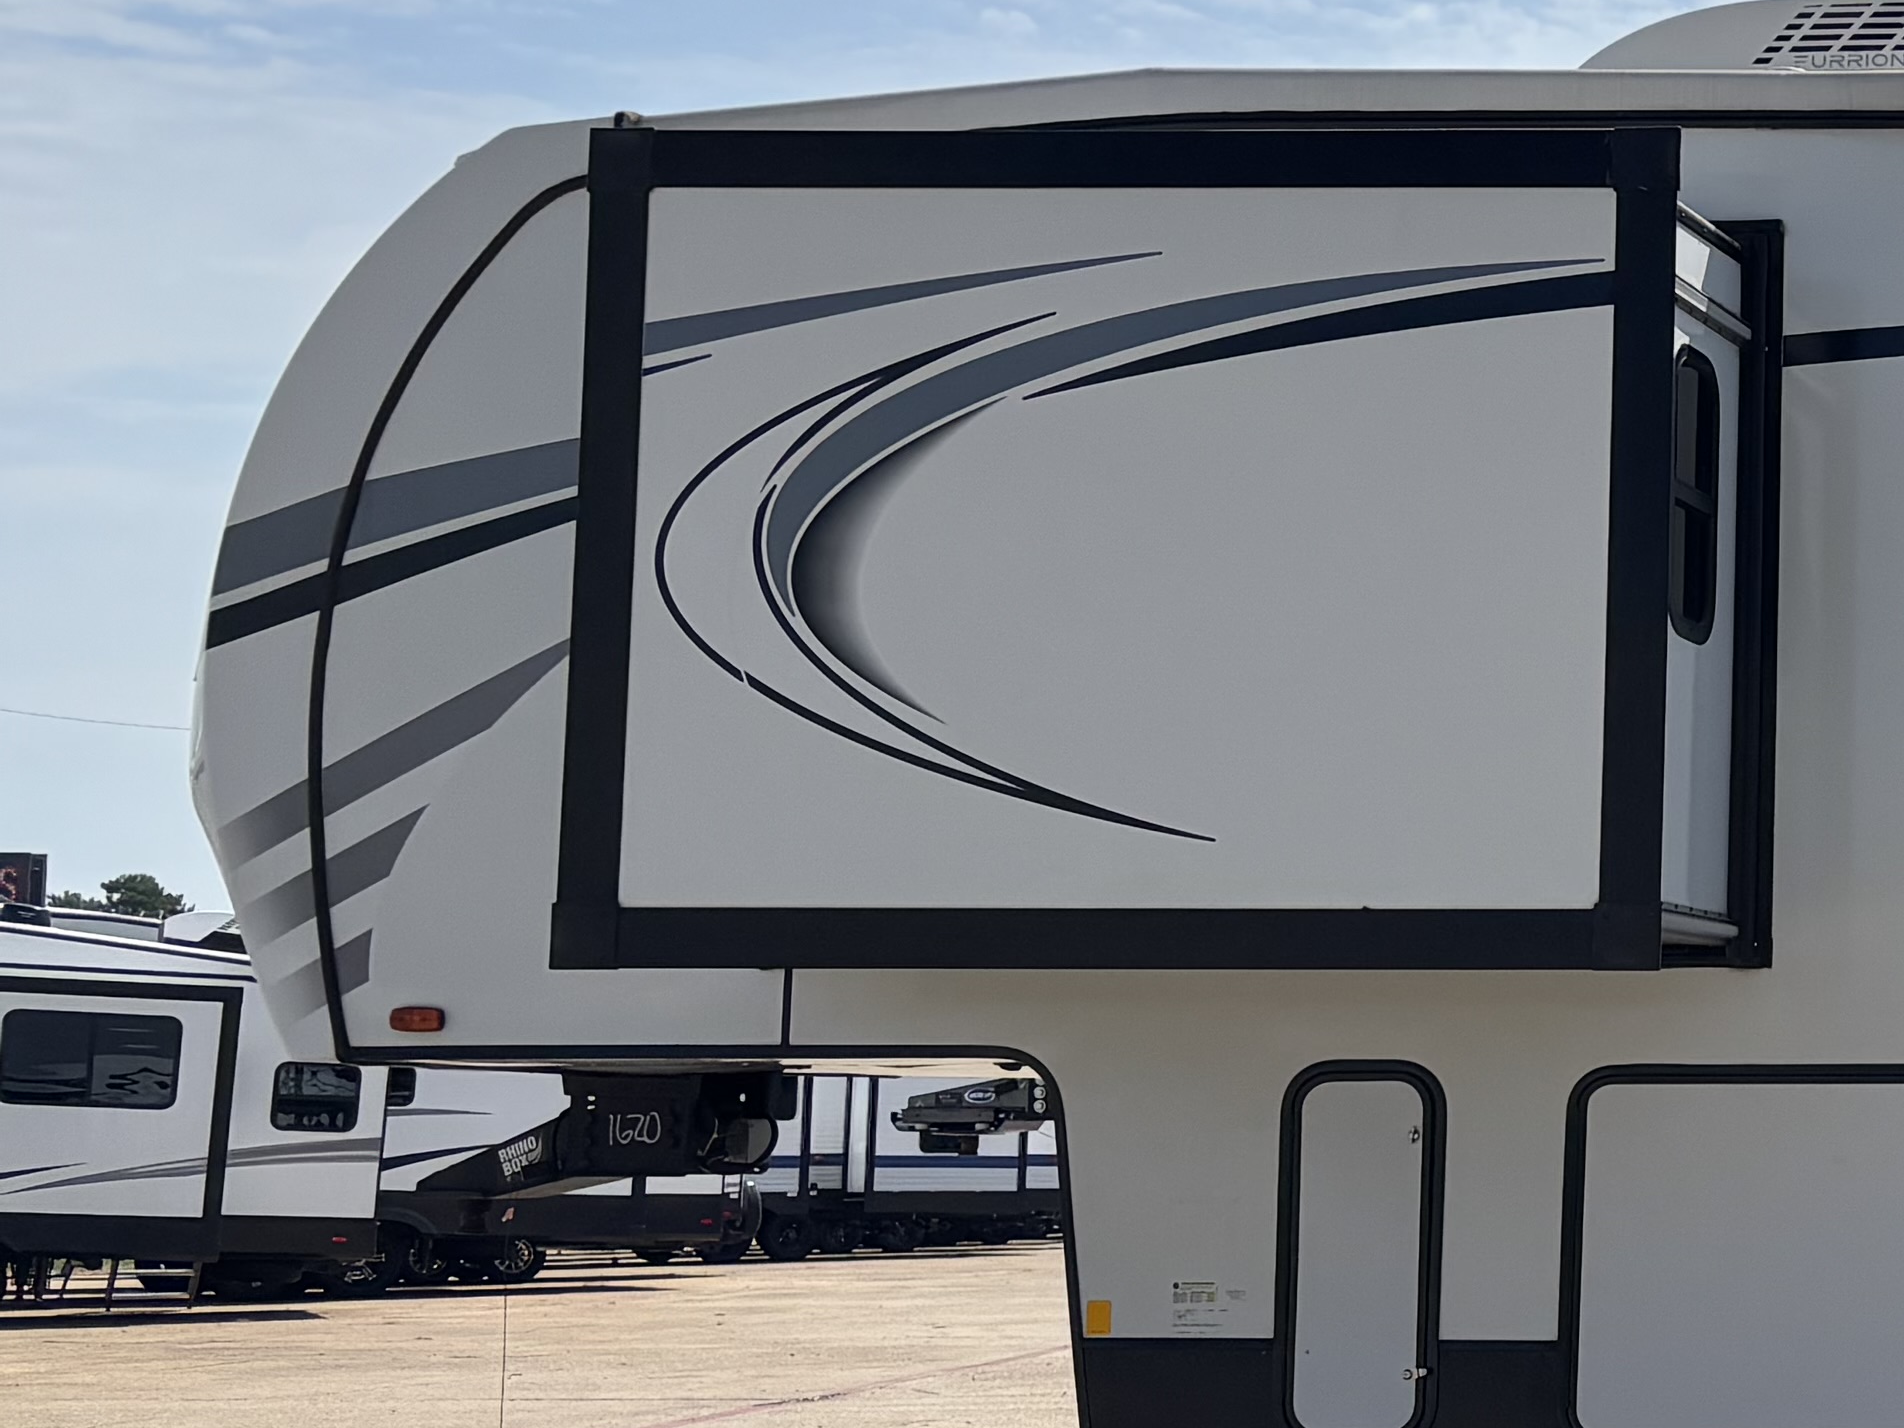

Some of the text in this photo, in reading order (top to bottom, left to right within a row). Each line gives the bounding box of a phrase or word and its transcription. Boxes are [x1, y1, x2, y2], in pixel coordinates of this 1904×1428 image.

[608, 1112, 662, 1146] 1620
[498, 1135, 537, 1163] RHINO
[502, 1153, 528, 1176] BOX
